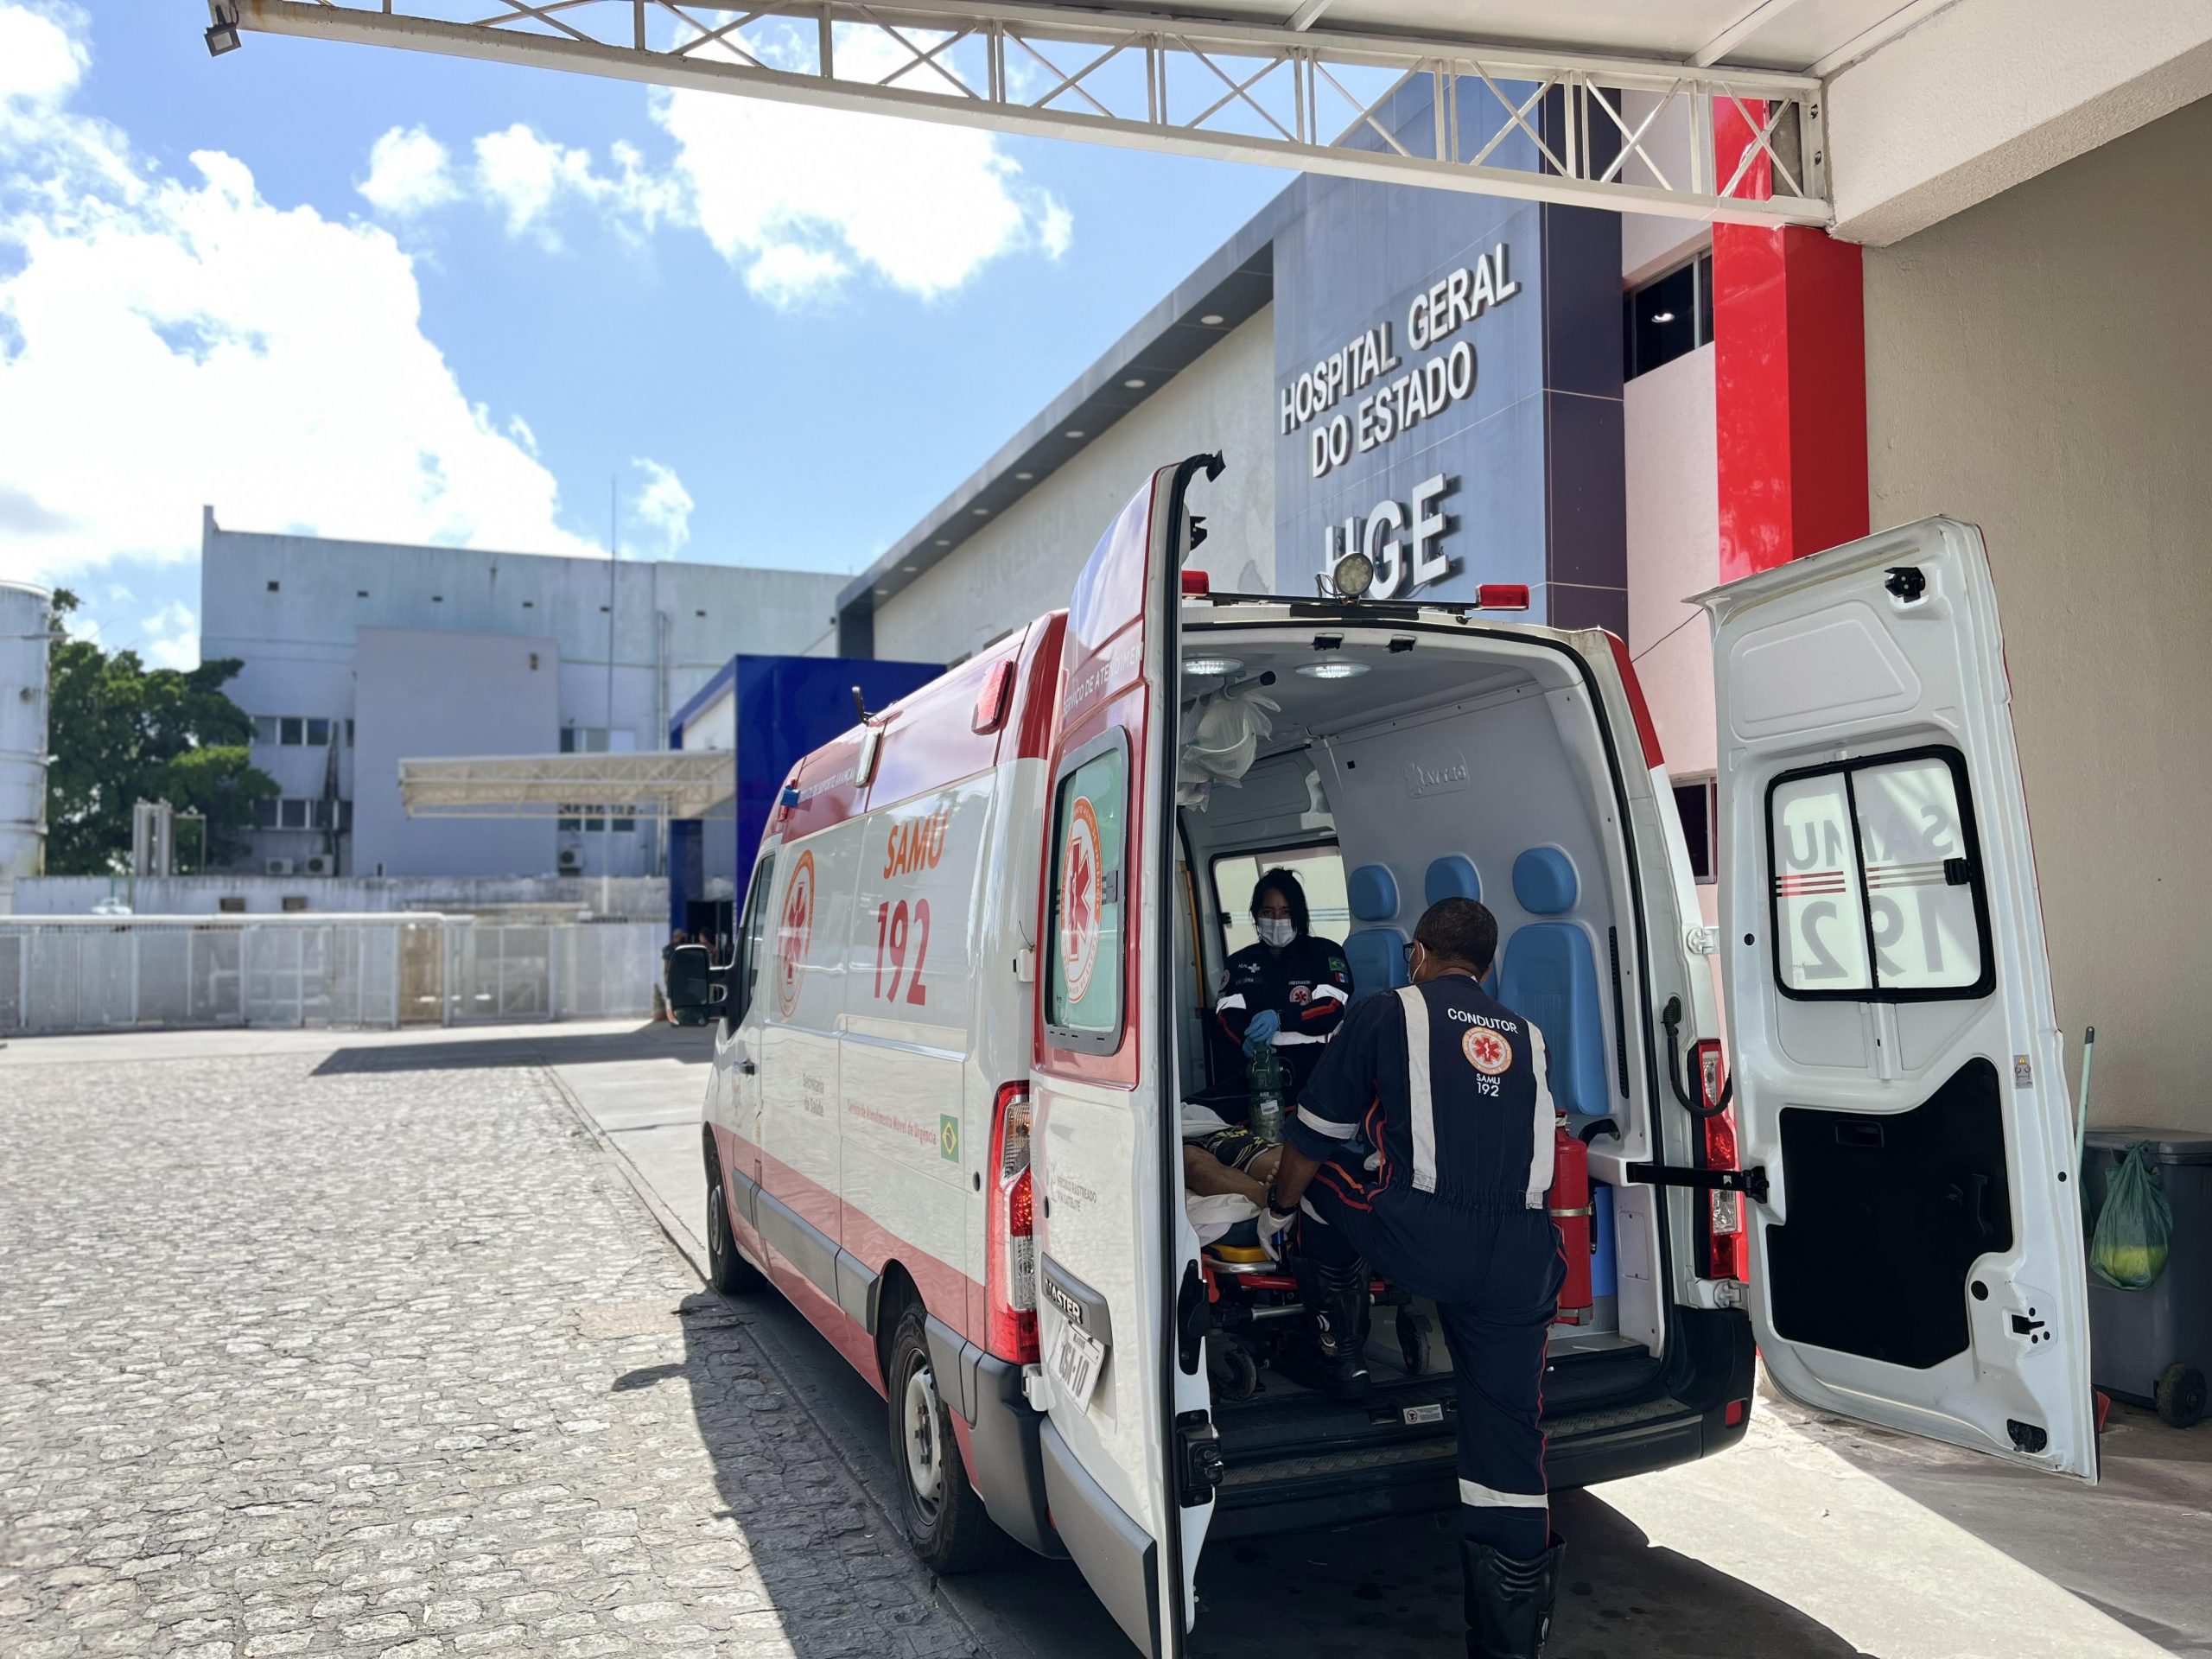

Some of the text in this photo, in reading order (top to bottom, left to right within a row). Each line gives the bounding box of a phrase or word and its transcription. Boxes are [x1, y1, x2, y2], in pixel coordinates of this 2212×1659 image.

[1281, 243, 1522, 435] HOSPITAL GERAL
[1313, 340, 1476, 478] DO ESTADO
[1325, 473, 1451, 600] HGE
[883, 810, 950, 880] SAMU
[874, 898, 931, 1007] 192
[1447, 1007, 1519, 1034] CONDUTOR
[1476, 1073, 1500, 1085] SAMU
[1477, 1082, 1499, 1097] 192
[1045, 1278, 1082, 1324] MASTER
